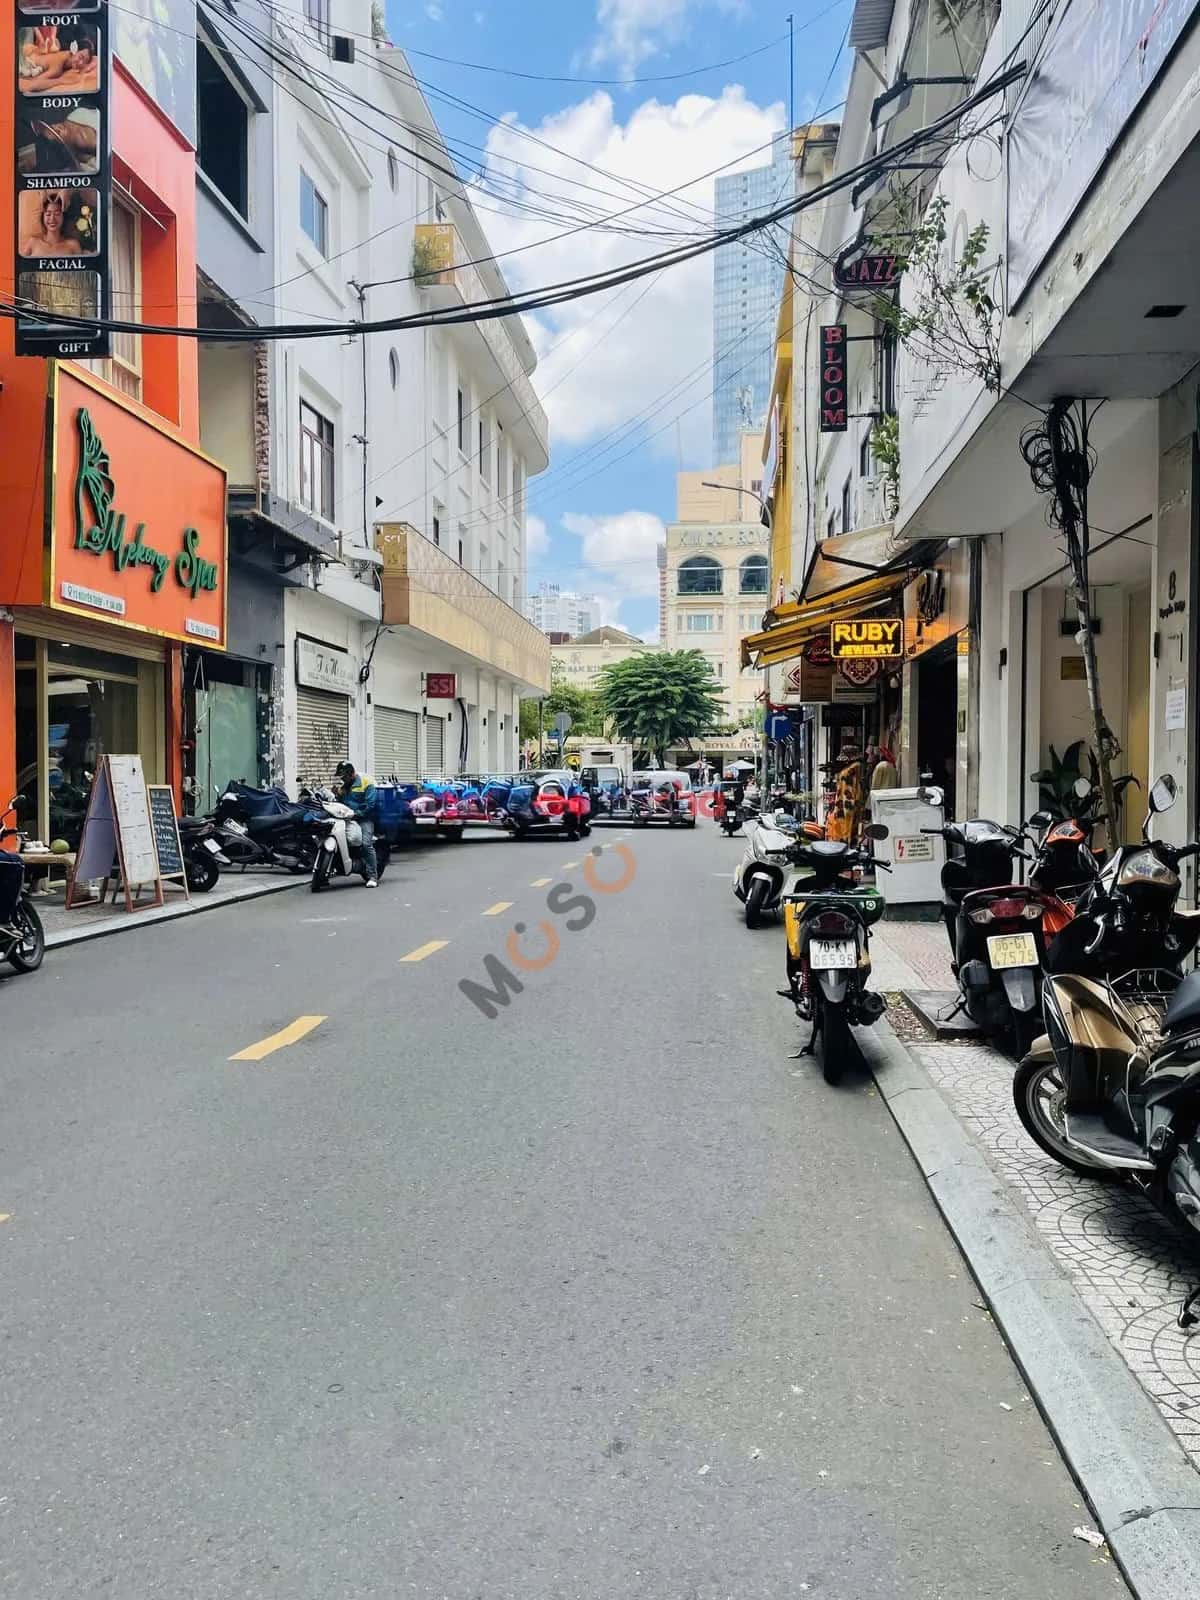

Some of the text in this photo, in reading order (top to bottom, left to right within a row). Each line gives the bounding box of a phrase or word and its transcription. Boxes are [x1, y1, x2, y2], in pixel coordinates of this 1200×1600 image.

[42, 15, 80, 27] FOOT
[42, 97, 82, 109] BODY
[26, 176, 91, 189] SHAMPOO
[39, 259, 86, 270] FACIAL
[846, 258, 896, 281] JAZZ
[58, 342, 91, 353] GIFT
[822, 326, 846, 427] BLOOM
[99, 508, 170, 594] Mekong
[174, 527, 218, 600] Spa
[1168, 569, 1177, 601] 8
[834, 622, 899, 642] RUBY
[839, 643, 896, 656] JEWELRY
[430, 678, 454, 694] SSI
